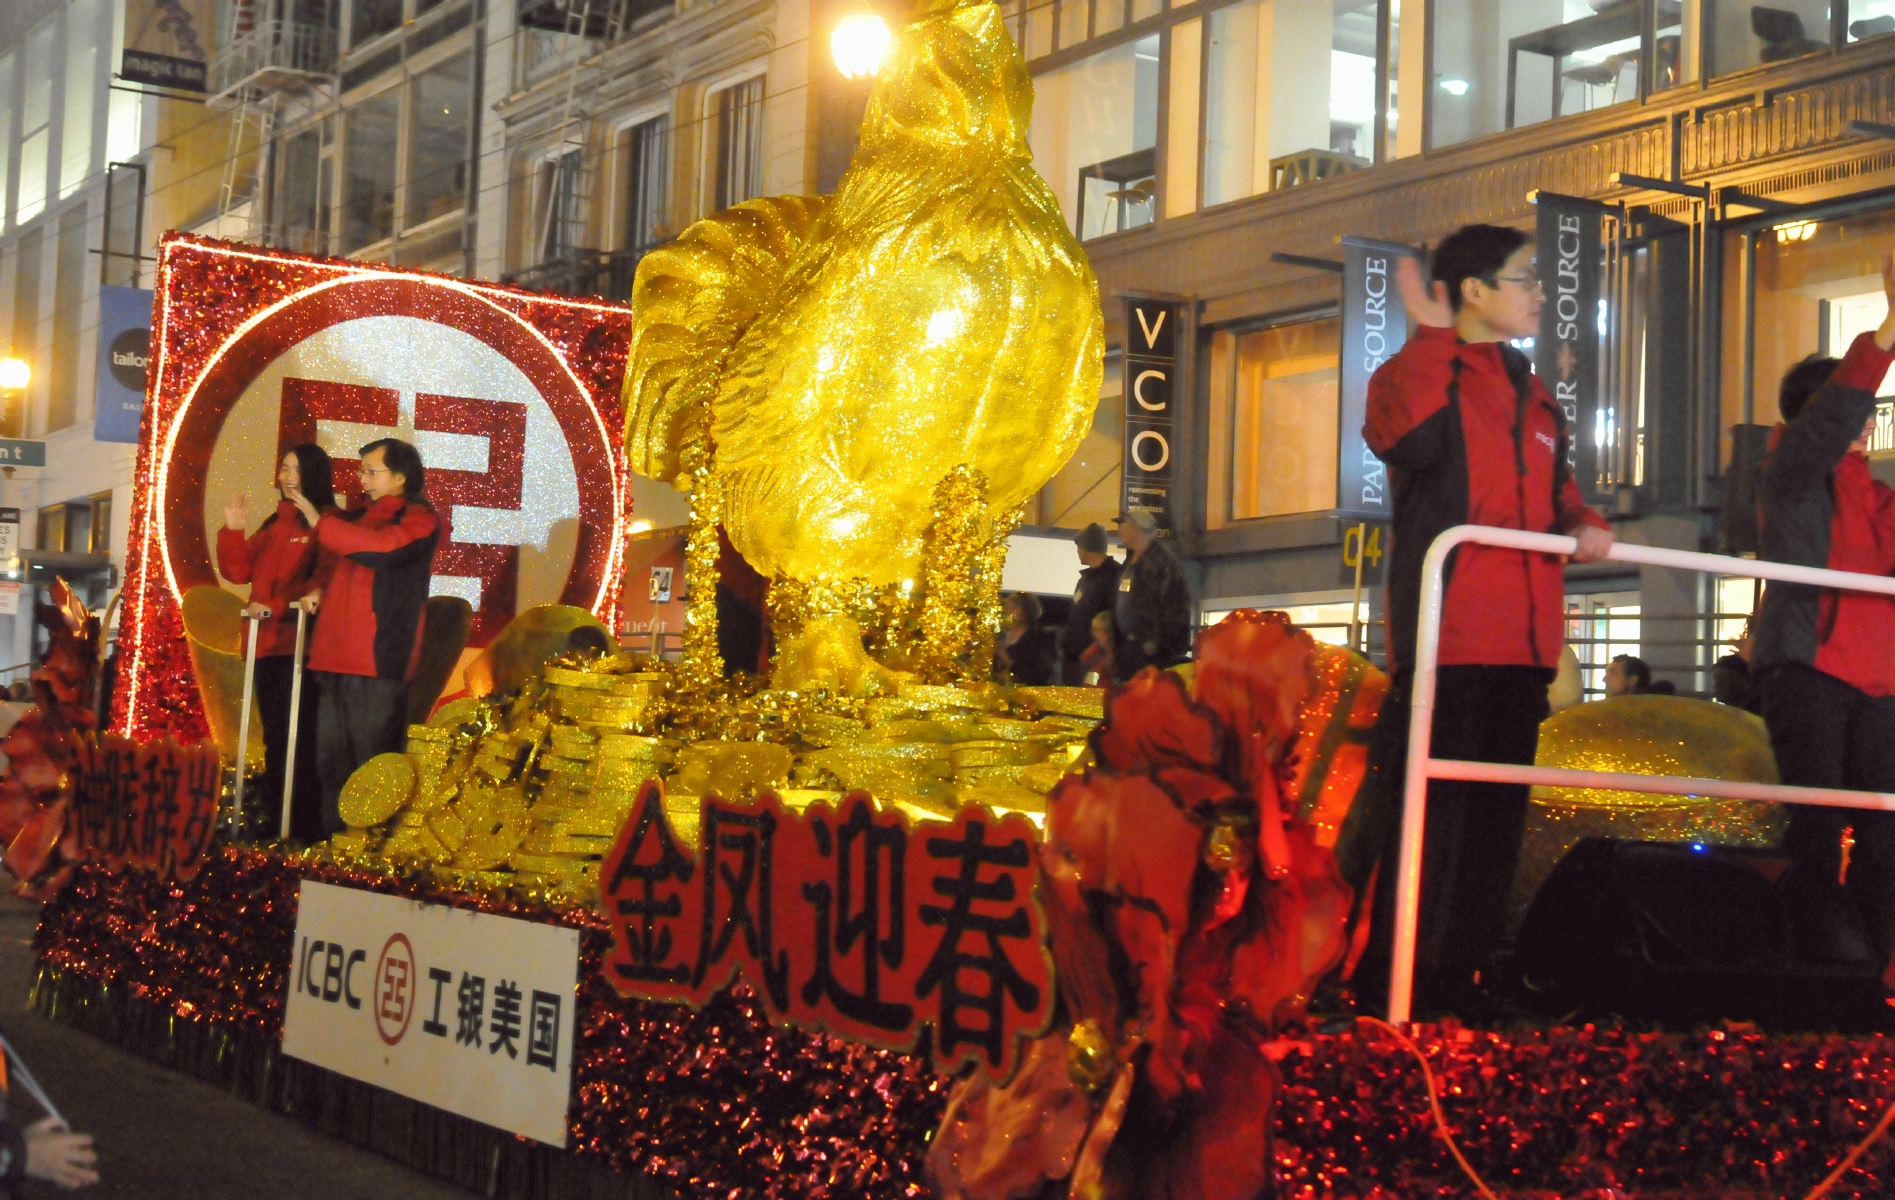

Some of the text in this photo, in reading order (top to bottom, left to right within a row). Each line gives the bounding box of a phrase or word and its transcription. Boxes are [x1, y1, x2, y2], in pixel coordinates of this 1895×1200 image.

[1363, 257, 1387, 373] SOURCE
[1557, 214, 1580, 341] SOURCE
[113, 351, 149, 368] tailor
[122, 402, 142, 411] SAL
[1128, 487, 1166, 497] reinventing
[1128, 495, 1140, 503] the
[608, 787, 1040, 1068] 金凤迎春
[297, 935, 367, 1011] ICBC
[422, 966, 562, 1074] 工银美国
